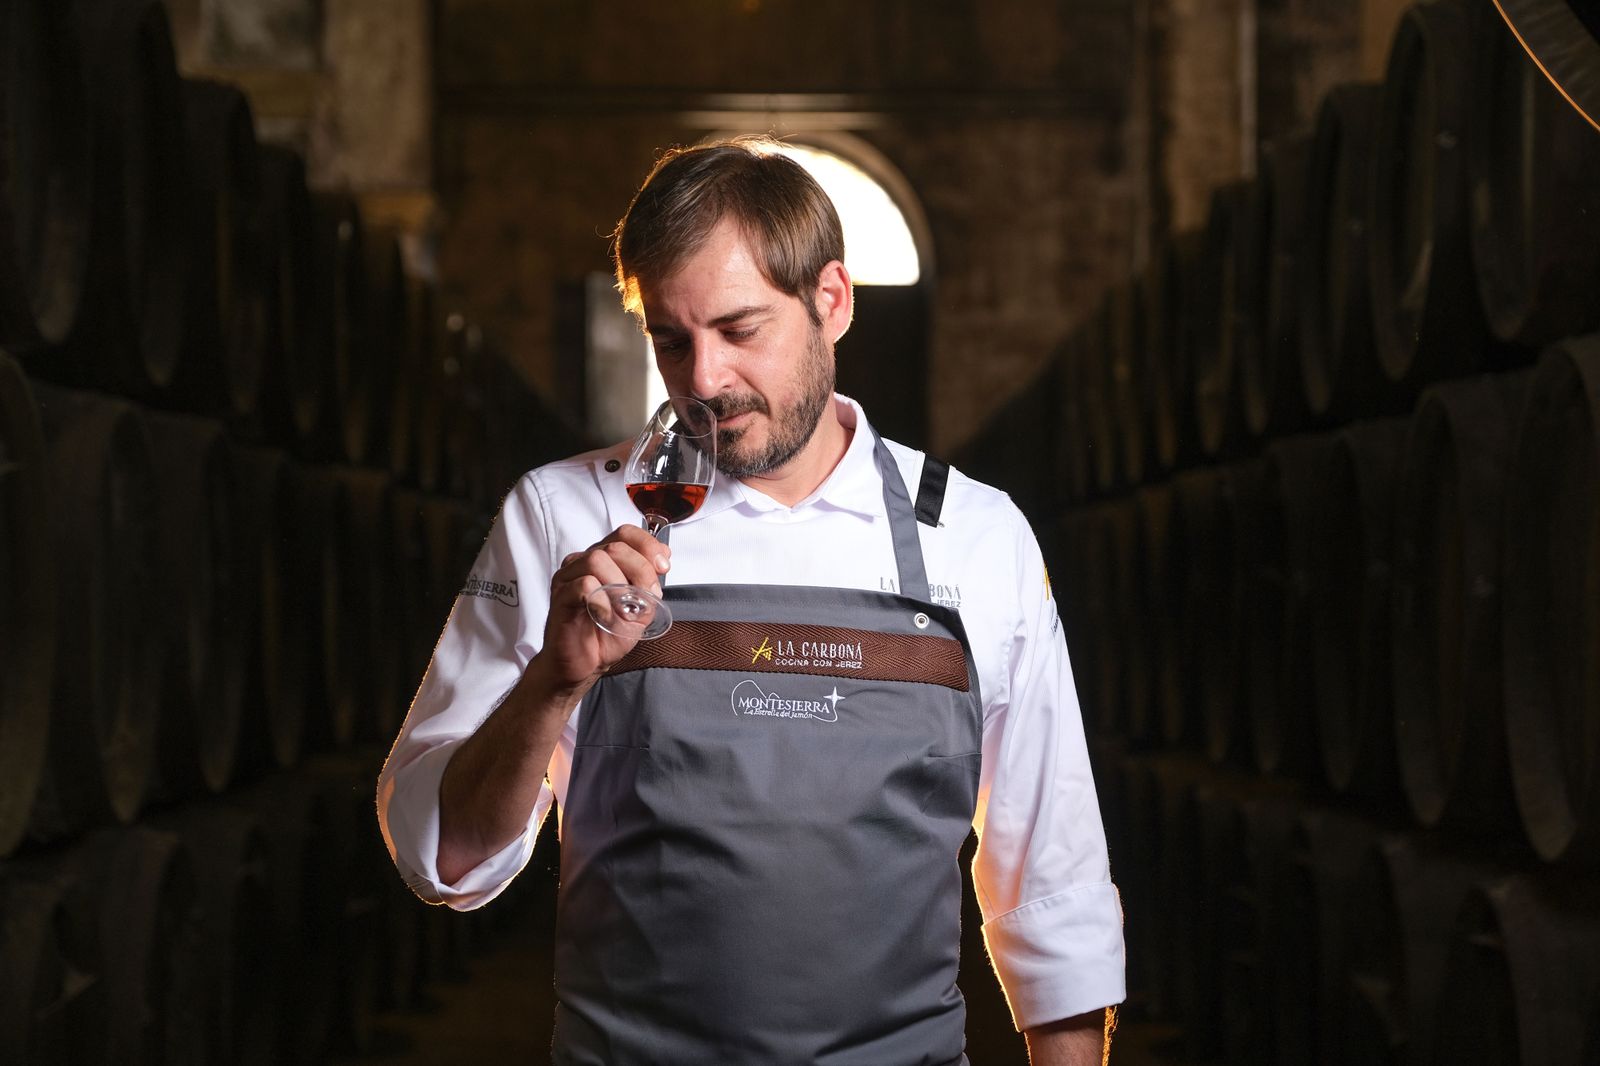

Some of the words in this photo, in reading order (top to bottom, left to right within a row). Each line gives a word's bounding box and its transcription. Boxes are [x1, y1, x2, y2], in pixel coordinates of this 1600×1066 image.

[880, 577, 896, 592] LA
[928, 583, 962, 601] BONÁ
[778, 640, 795, 656] LA
[801, 641, 863, 661] CARBONÁ
[775, 658, 809, 666] COCINA
[835, 661, 863, 669] JEREZ
[738, 697, 830, 714] MONTESIERRA
[744, 706, 754, 715] La
[754, 707, 780, 718] Estrella
[780, 710, 790, 718] del
